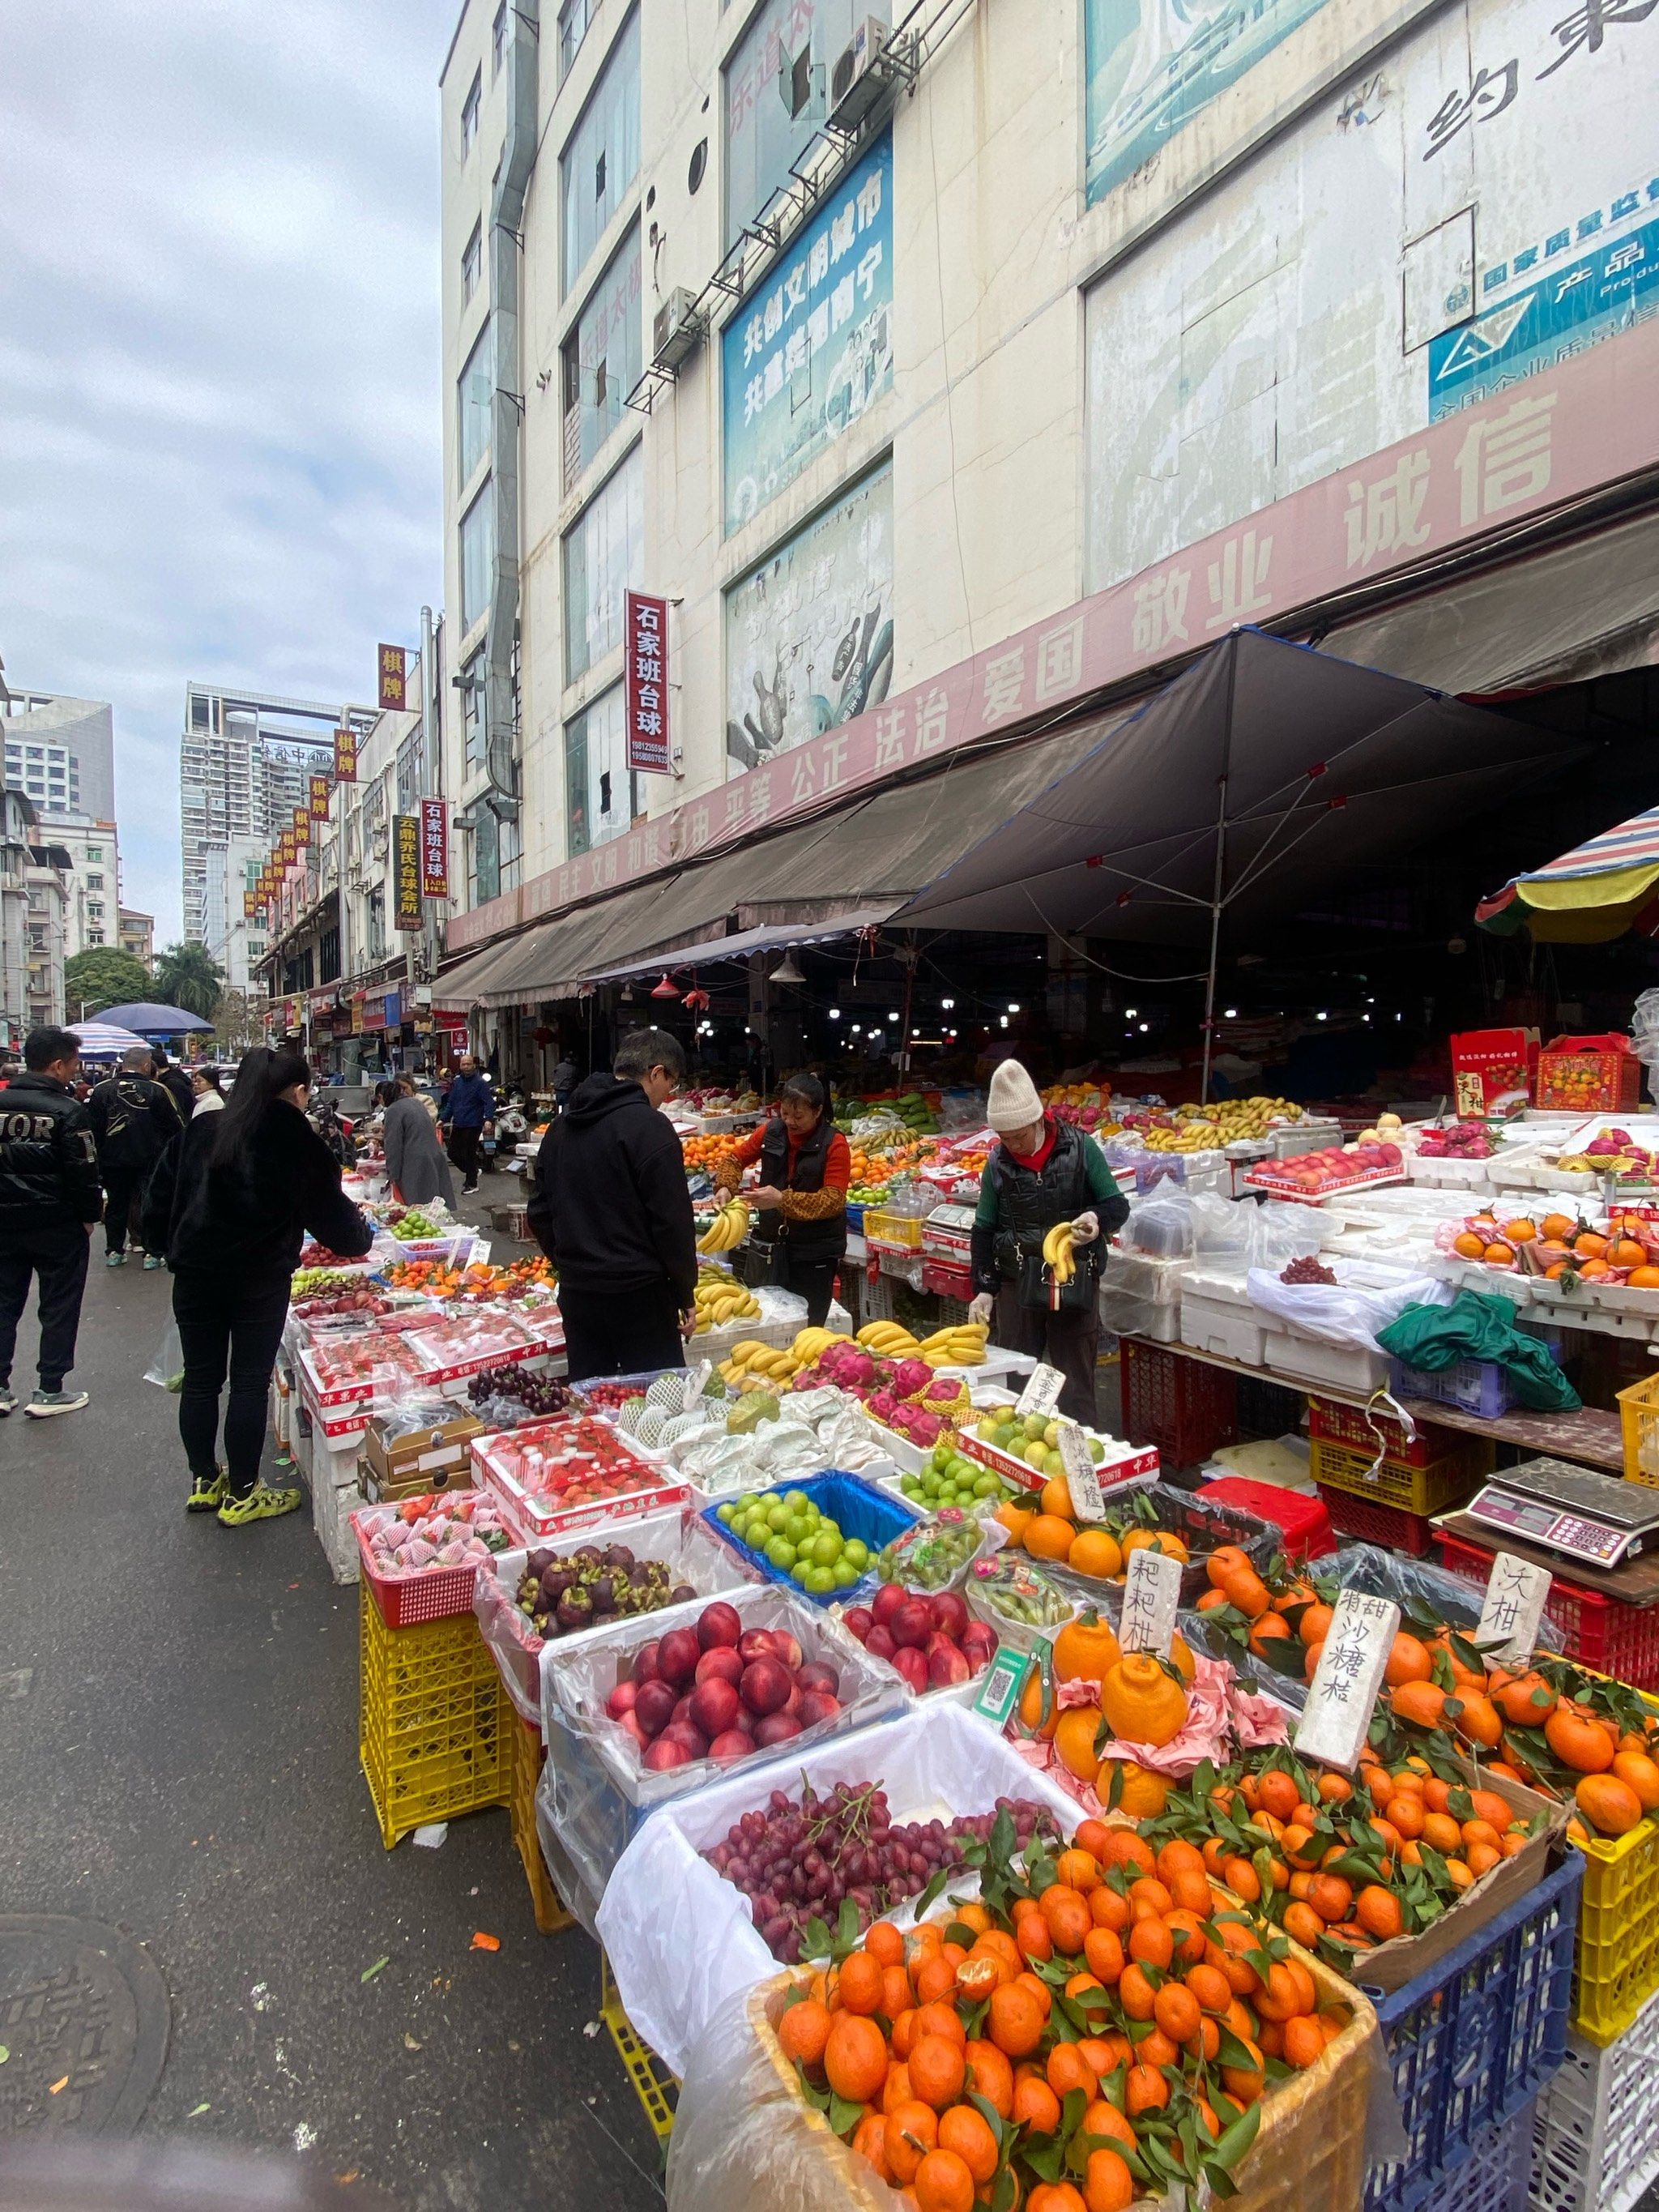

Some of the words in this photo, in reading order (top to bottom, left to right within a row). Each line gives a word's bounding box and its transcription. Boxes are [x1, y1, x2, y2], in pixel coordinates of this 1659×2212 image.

[726, 773, 771, 824] 平等
[791, 733, 849, 805] 公正
[873, 686, 949, 773] 法治
[983, 616, 1084, 724] 爱国
[1132, 529, 1274, 657] 敬业
[1343, 389, 1558, 570] 诚信
[382, 649, 403, 701] 棋牌
[636, 604, 662, 736] 石家班台球
[338, 734, 356, 775] 棋牌
[313, 780, 326, 815] 棋牌
[283, 834, 295, 861] 棋牌
[296, 811, 309, 842] 棋牌
[426, 804, 444, 878] 石家班台球
[273, 852, 284, 878] 棋牌
[399, 817, 418, 915] 云鼎乔氏台球会所
[521, 1343, 545, 1356] 中华
[322, 1388, 368, 1406] 华果业
[1073, 1444, 1102, 1509] 冰糖橙
[1133, 1454, 1157, 1474] 中华
[1123, 1555, 1159, 1653] 耙耙柑
[1337, 1589, 1390, 1620] 特甜
[1483, 1557, 1533, 1631] 沃柑
[1320, 1616, 1371, 1703] 沙糖桔
